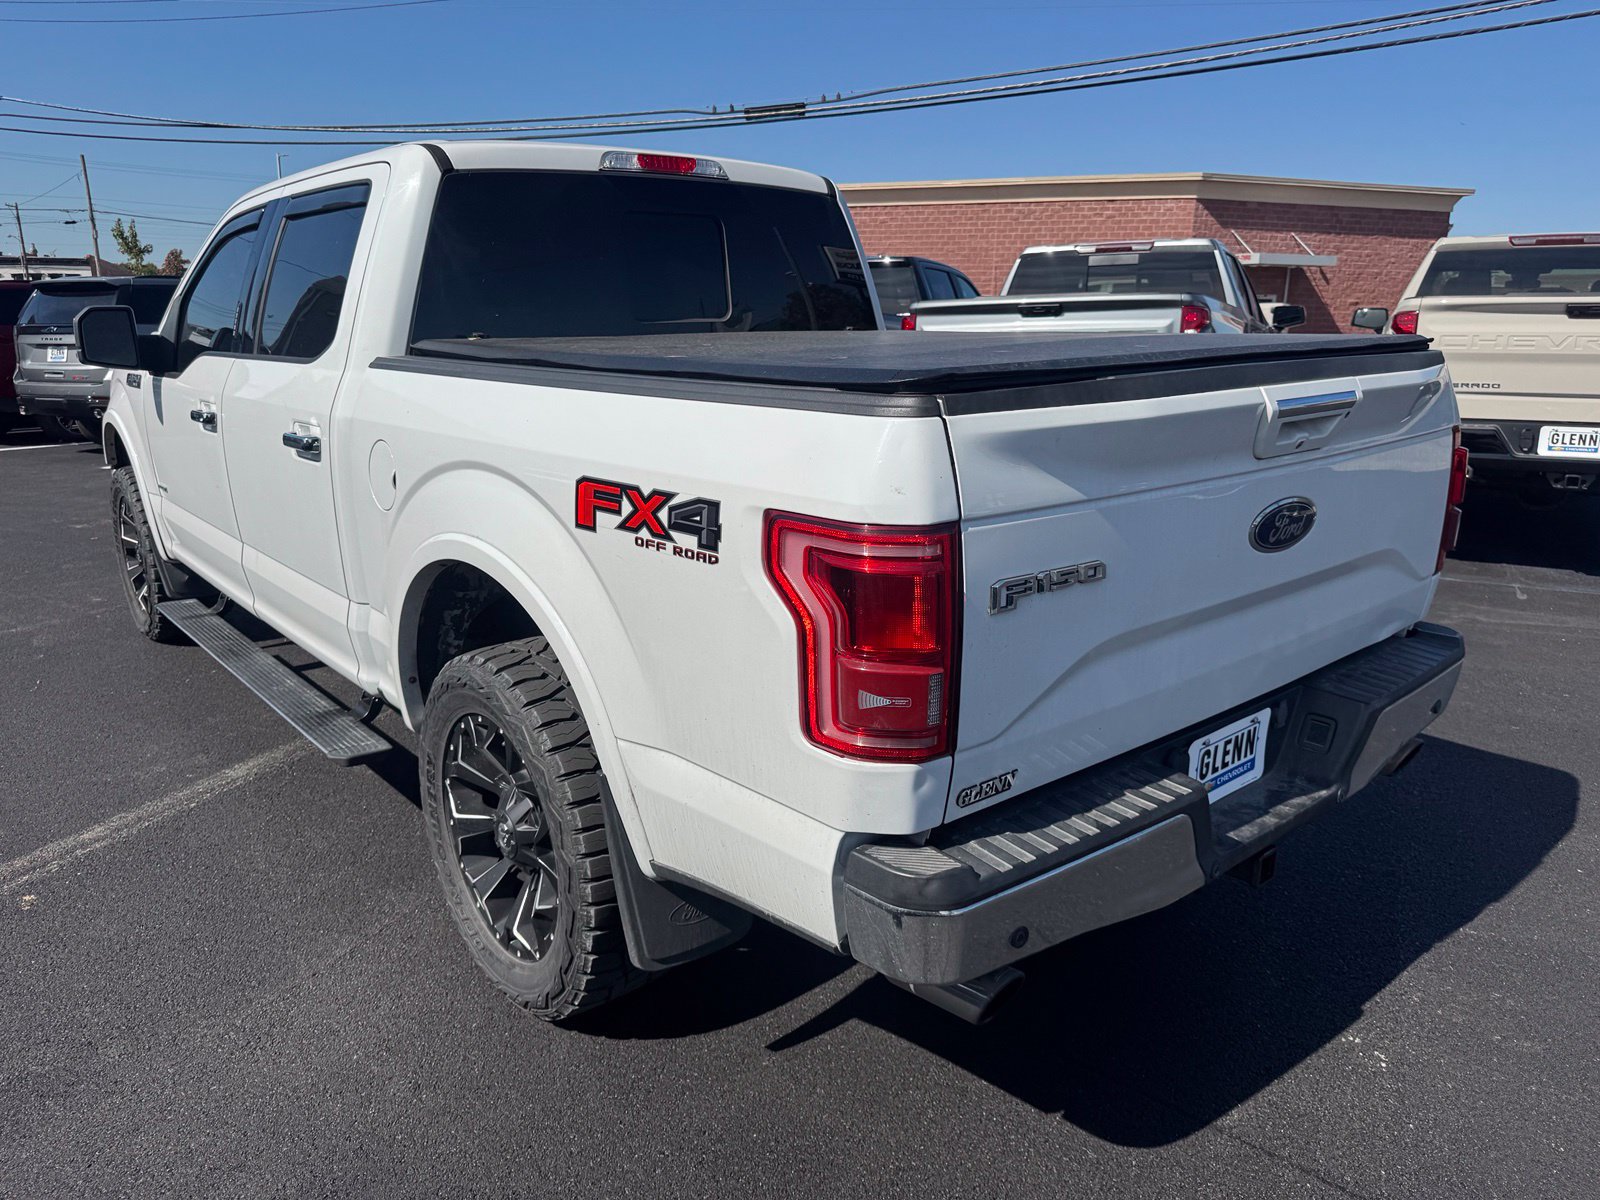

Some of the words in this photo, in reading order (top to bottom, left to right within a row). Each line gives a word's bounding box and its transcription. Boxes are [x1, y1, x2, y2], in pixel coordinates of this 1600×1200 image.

[1551, 433, 1598, 446] GLENN
[575, 475, 722, 554] FX4
[1269, 508, 1308, 544] Ford
[634, 536, 667, 552] OFF
[672, 545, 719, 565] ROAD
[1198, 726, 1258, 781] GLENN
[956, 768, 1019, 809] GLENN
[1216, 761, 1252, 785] CHEVROLET
